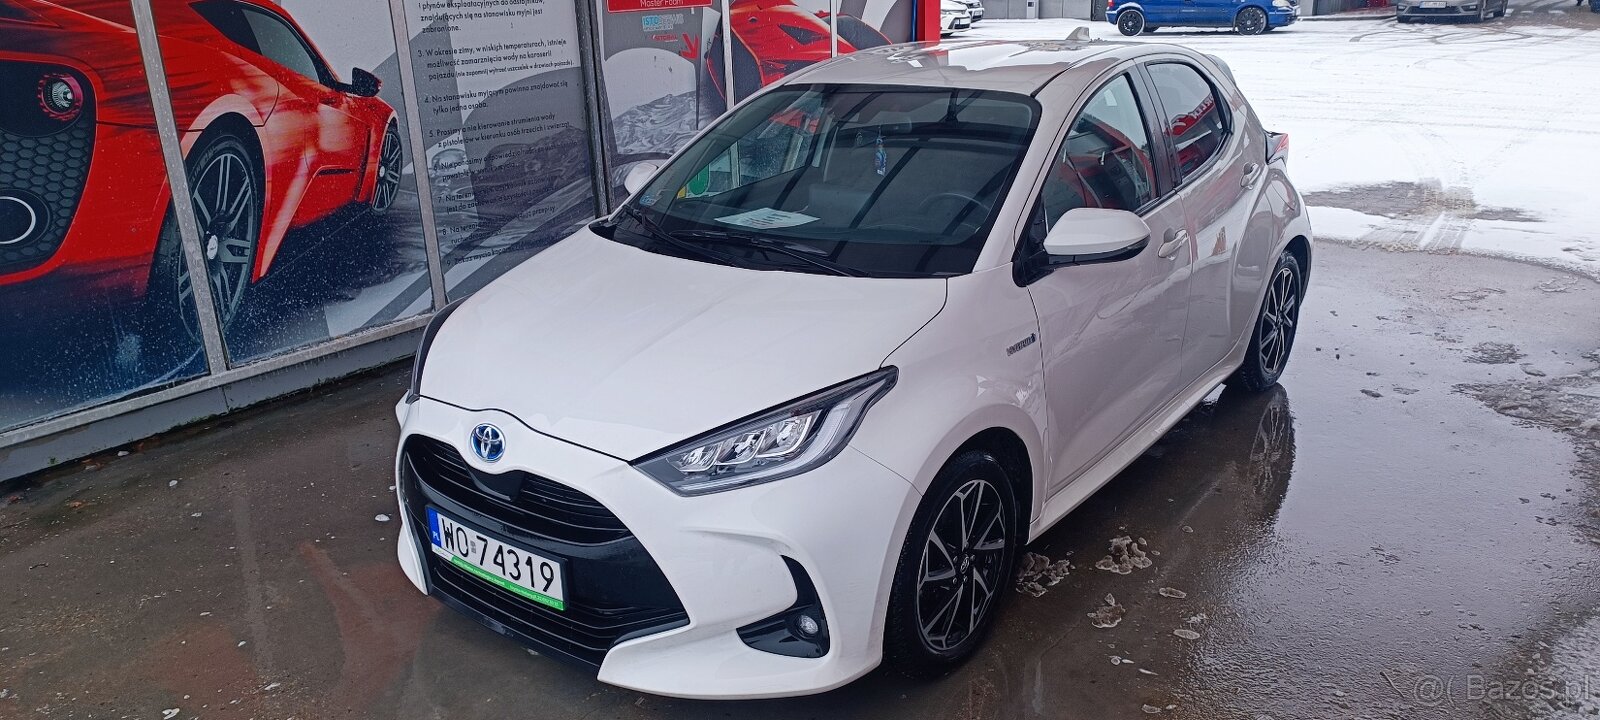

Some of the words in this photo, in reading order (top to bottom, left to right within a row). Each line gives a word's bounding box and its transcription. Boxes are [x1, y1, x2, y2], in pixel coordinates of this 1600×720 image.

[422, 1, 445, 11] płynów
[446, 0, 499, 9] eksploatacyjnych
[640, 0, 662, 8] Master
[421, 11, 463, 22] znajdujących
[464, 12, 473, 20] się
[483, 9, 515, 19] stanowisku
[516, 9, 532, 18] myjni
[422, 25, 461, 34] zabranione.
[434, 47, 457, 56] okresie
[458, 47, 475, 55] zimy,
[482, 43, 503, 52] niskich
[504, 39, 546, 50] temperaturach,
[547, 39, 567, 47] istnieje
[427, 58, 460, 68] możliwość
[461, 55, 501, 65] zamarznięcia
[502, 52, 518, 61] wody
[528, 50, 552, 58] karoserii
[428, 70, 454, 81] pojazdu
[466, 68, 488, 76] zapomnij
[425, 95, 431, 103] 4.
[443, 90, 477, 102] stanowisku
[478, 89, 504, 98] myjącym
[504, 85, 529, 95] powinna
[530, 81, 559, 91] znajdować
[433, 105, 448, 115] tylko
[449, 104, 467, 114] jedna
[468, 101, 489, 110] osoba.
[437, 128, 461, 136] Prosimy
[478, 120, 510, 130] kierowanie
[511, 115, 540, 125] strumienia
[541, 112, 555, 121] wody
[443, 137, 474, 148] pistoletów
[481, 131, 505, 140] kierunku
[506, 127, 520, 136] osób
[521, 126, 543, 134] trzecich
[441, 161, 453, 170] Nie
[446, 206, 457, 215] jest
[450, 226, 460, 234] Na
[441, 517, 469, 558] WO
[475, 534, 555, 593] 74319
